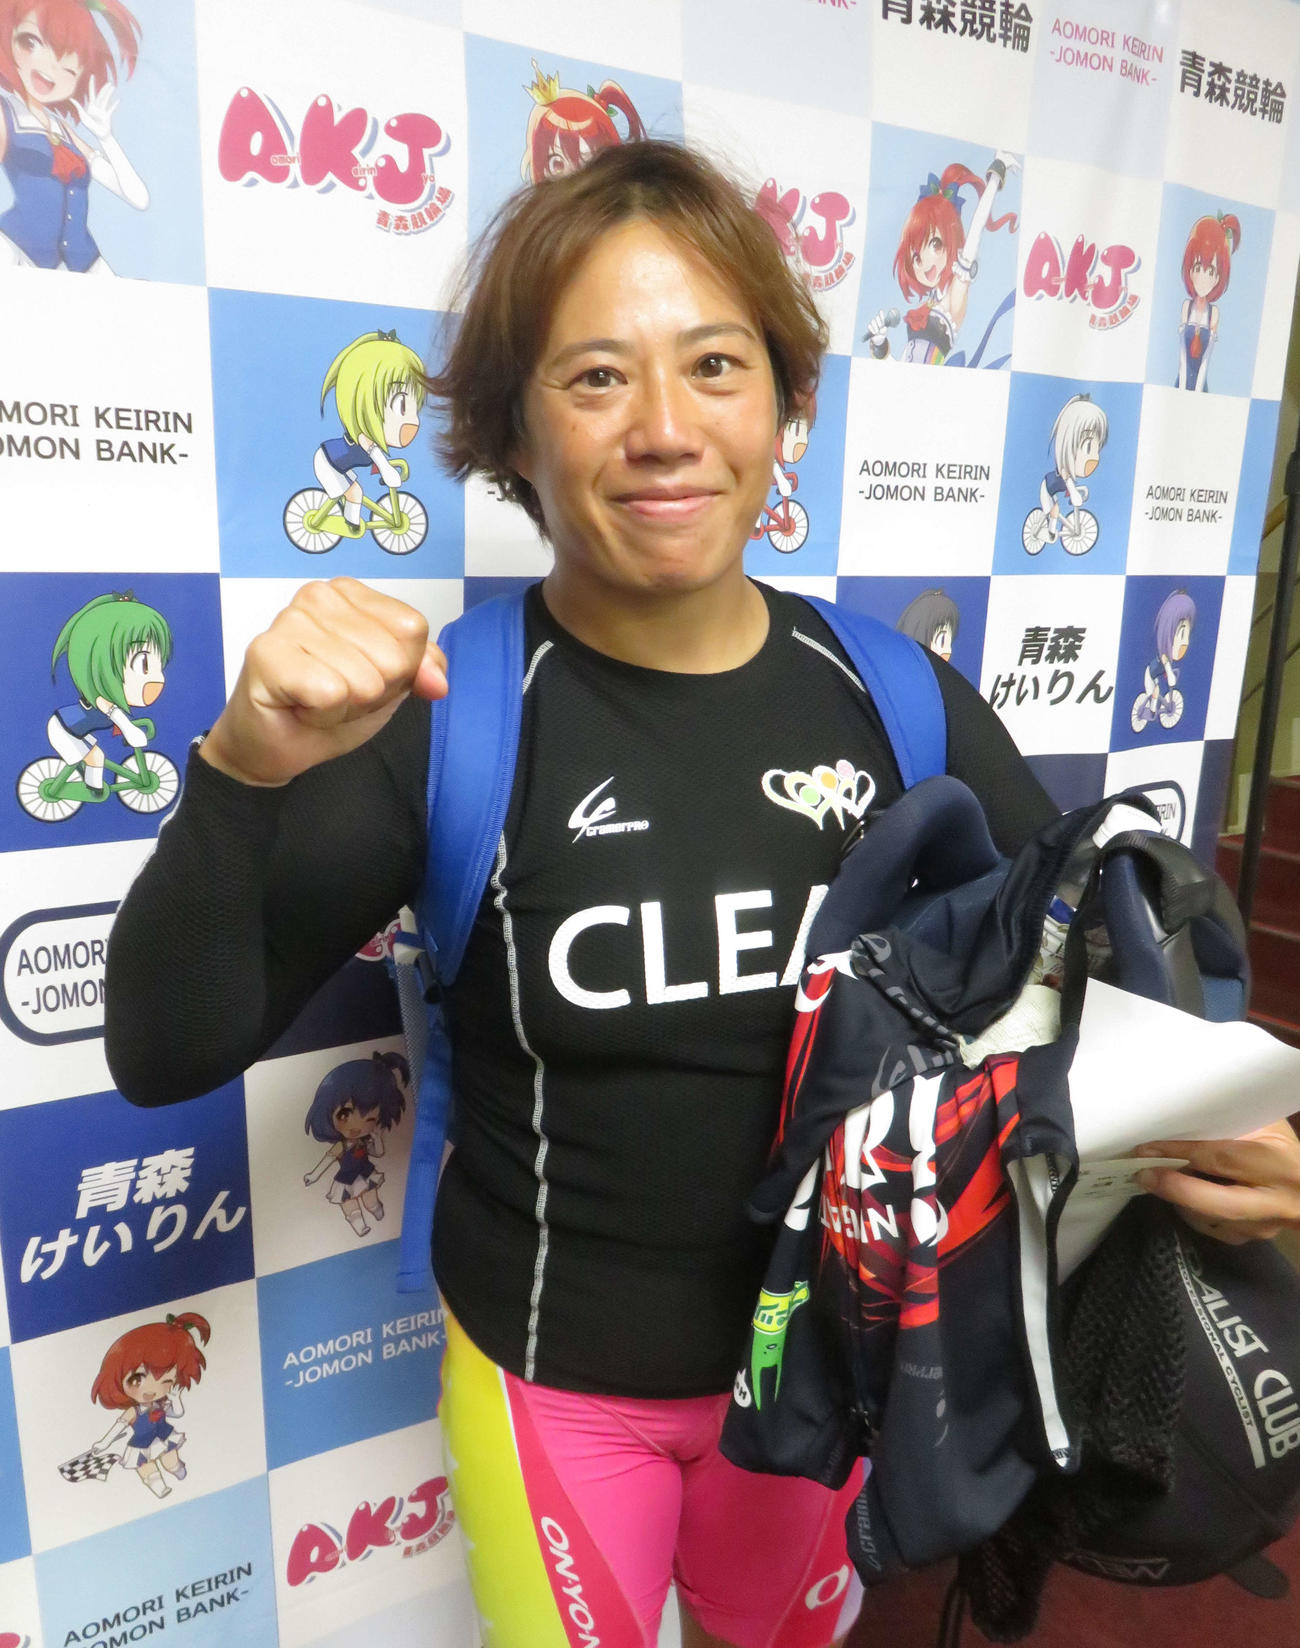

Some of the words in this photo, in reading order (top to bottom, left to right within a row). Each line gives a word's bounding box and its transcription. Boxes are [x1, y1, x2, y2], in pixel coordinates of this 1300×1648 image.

[1050, 46, 1114, 73] -JOMON
[1120, 59, 1158, 87] BANK-
[1051, 18, 1116, 49] AOMORI
[1122, 34, 1164, 64] KEIRIN
[1179, 49, 1287, 124] 青森競輪
[218, 86, 443, 205] AKJ
[755, 177, 850, 267] KJ
[1023, 231, 1136, 309] AKJ
[0, 400, 80, 427] MORI
[94, 406, 193, 434] KEIRIN
[0, 434, 81, 461] MON
[96, 438, 189, 465] BANK-
[859, 460, 928, 479] AOMORI
[935, 463, 991, 481] KEIRIN
[859, 483, 926, 502] -JOMON
[934, 486, 985, 503] BANK-
[1145, 506, 1184, 521] -JOMON
[1186, 508, 1223, 523] BANK-
[1146, 485, 1186, 502] AOMORI
[1189, 488, 1229, 504] KEIRIN
[1018, 625, 1087, 667] 青森
[989, 669, 1114, 709] けいりん
[17, 938, 108, 977] AOMOR
[75, 1147, 195, 1220] 青森
[20, 1190, 247, 1284] けいりん
[282, 1327, 373, 1369] AOMORI
[285, 1349, 373, 1388] -JOMON
[382, 1330, 447, 1360] BANK-
[1224, 1365, 1255, 1428] CYCLIST
[1253, 1369, 1300, 1459] CLUB
[287, 1476, 449, 1587] AKJ
[63, 1594, 165, 1648] AOMORI
[175, 1562, 253, 1603] KEIRIN
[86, 1615, 165, 1648] MON
[176, 1587, 250, 1624] BANK-
